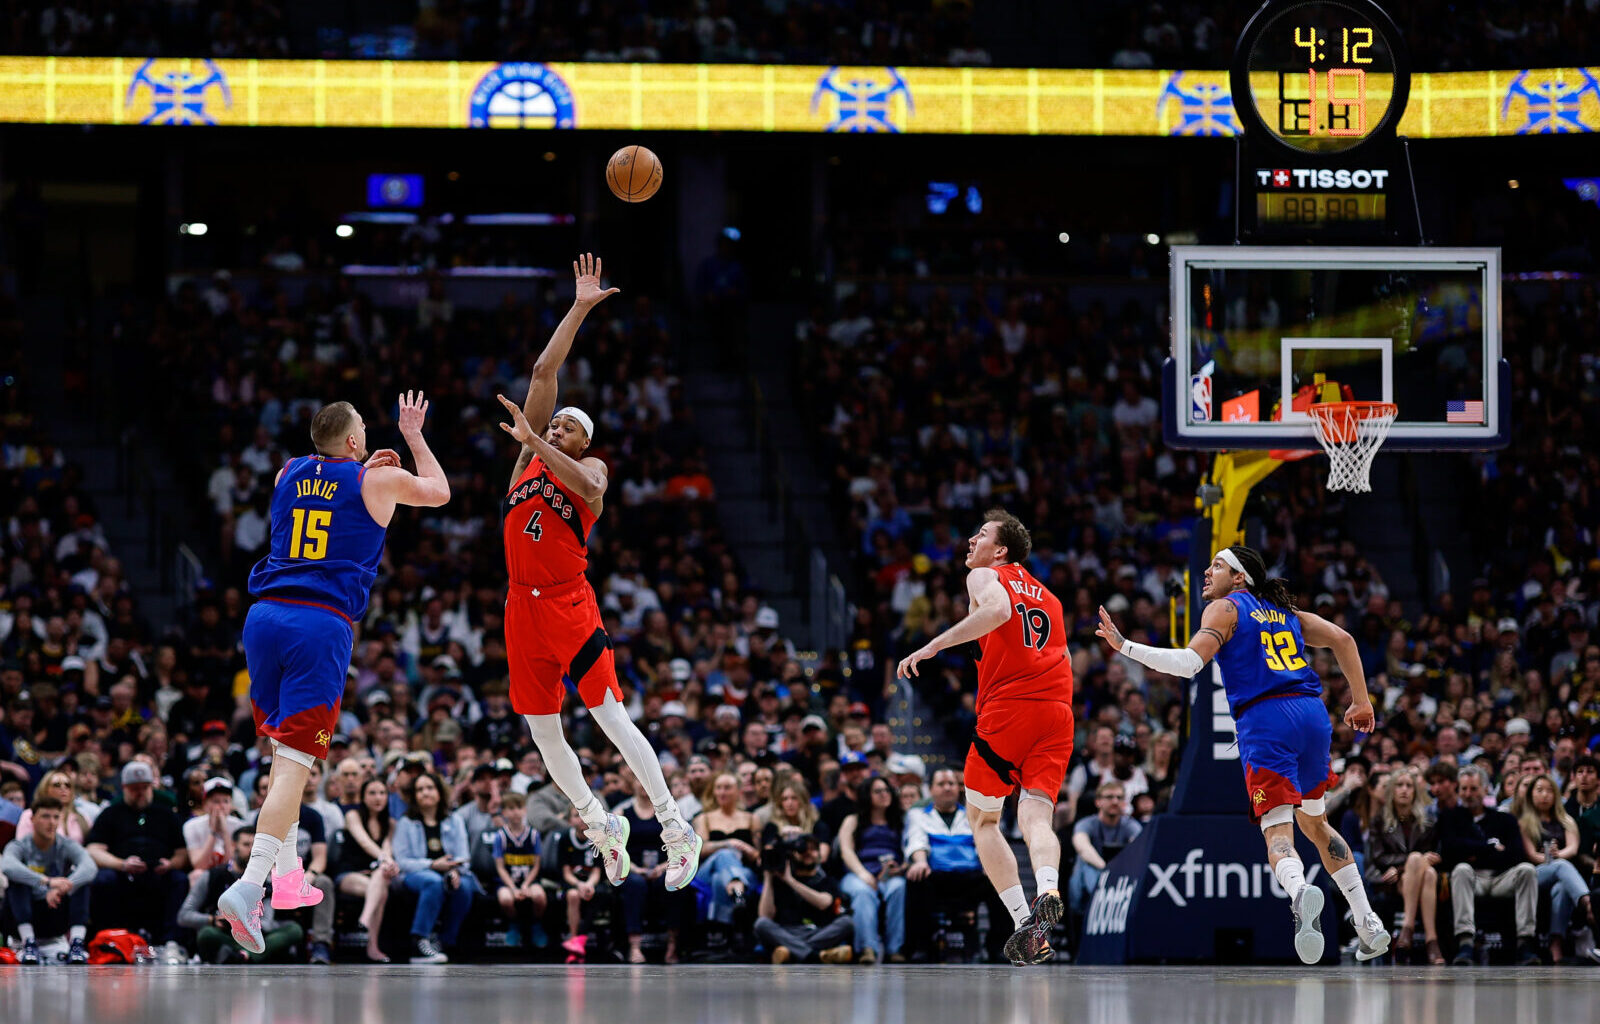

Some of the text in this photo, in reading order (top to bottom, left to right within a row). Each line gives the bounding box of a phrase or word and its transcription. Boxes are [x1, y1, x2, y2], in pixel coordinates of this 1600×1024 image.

[1294, 26, 1374, 64] 4:12
[1308, 67, 1366, 136] 19
[1292, 168, 1389, 189] TISSOT
[296, 478, 339, 501] JOKIĆ
[508, 477, 573, 519] RAPORS
[289, 508, 333, 560] 15
[523, 510, 543, 542] 4
[1014, 602, 1051, 652] 19
[1260, 630, 1308, 672] 32
